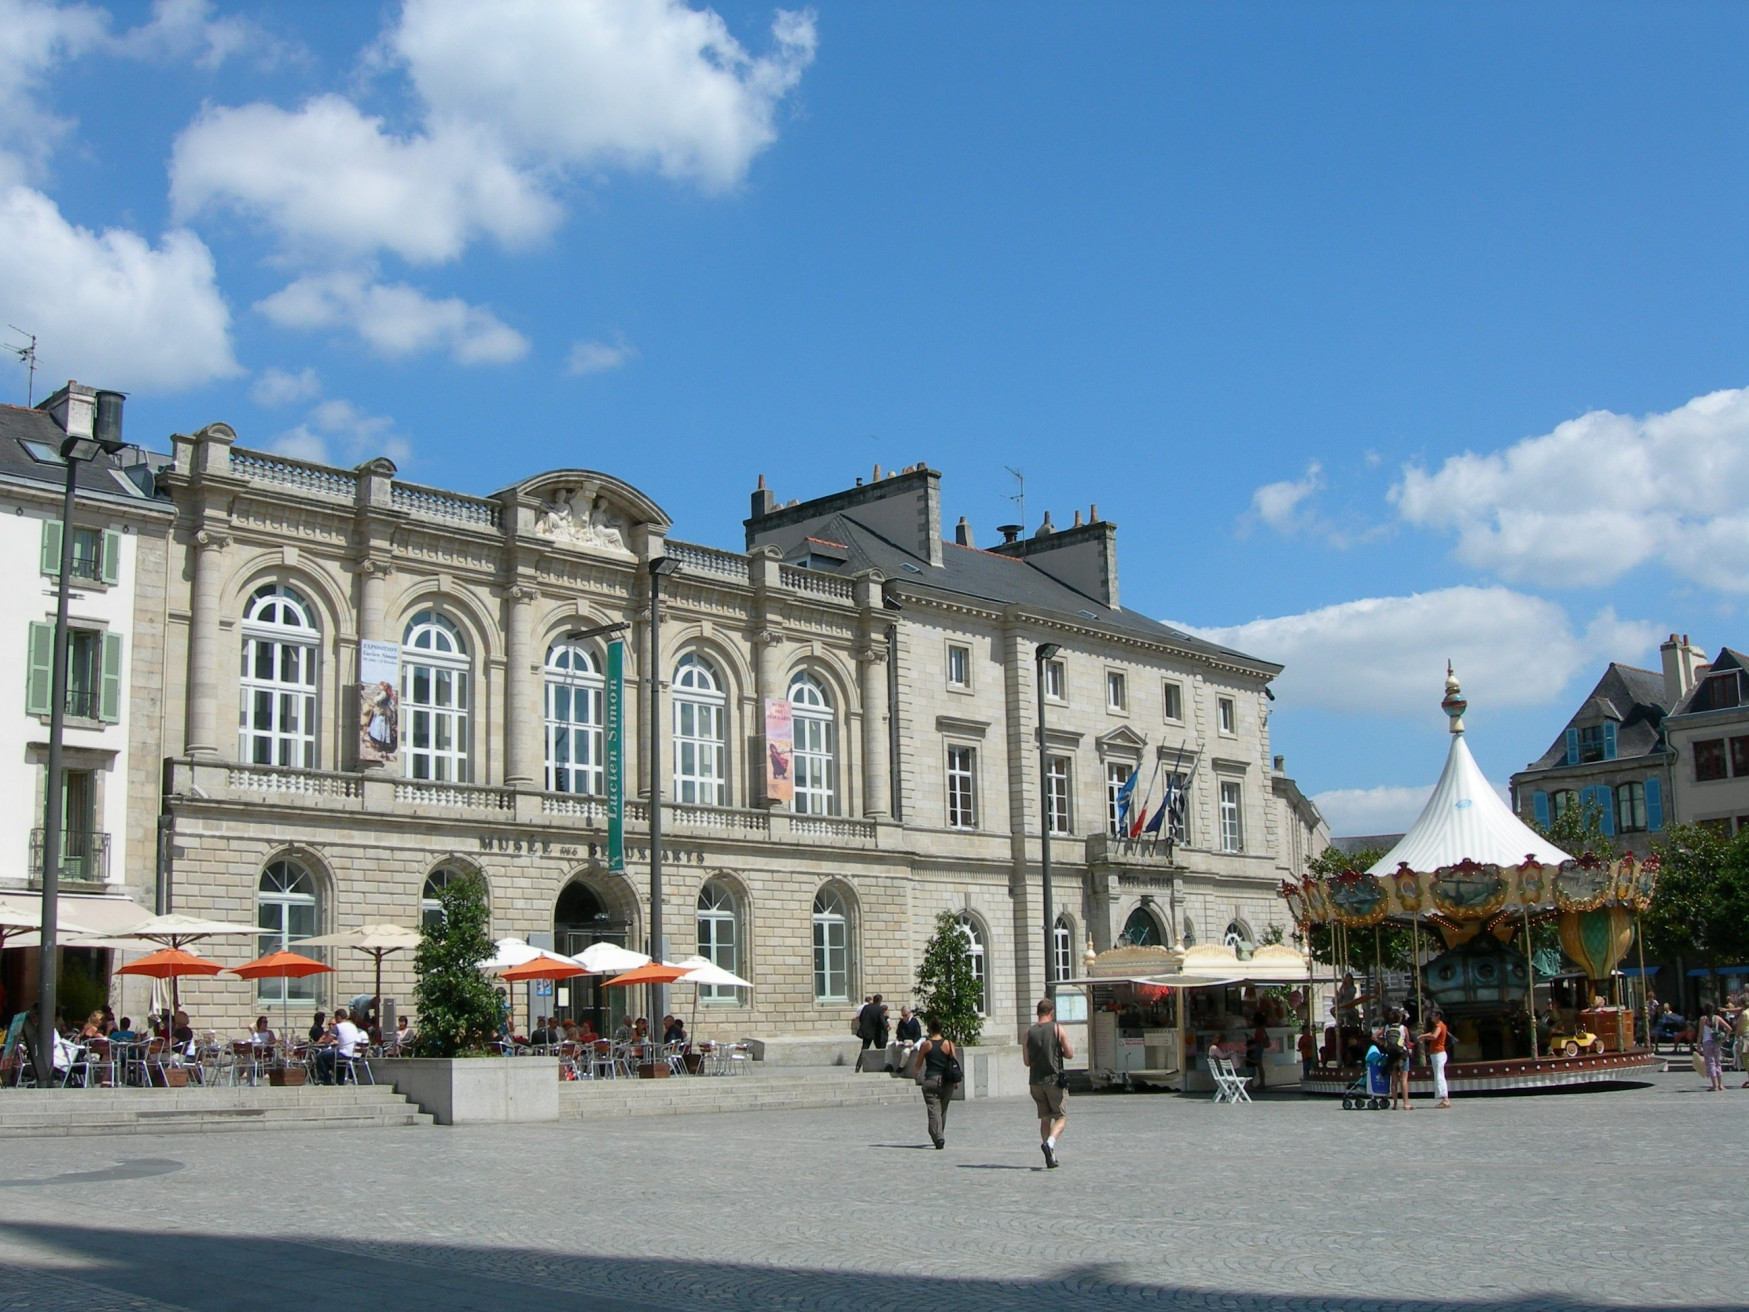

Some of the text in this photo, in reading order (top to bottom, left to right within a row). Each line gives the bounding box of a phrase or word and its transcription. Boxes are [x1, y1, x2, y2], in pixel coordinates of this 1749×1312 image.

[363, 643, 398, 653] EXPOSITION
[607, 679, 618, 820] Lucien Simon
[479, 834, 552, 855] MUSÉE
[587, 843, 647, 861] BEUX
